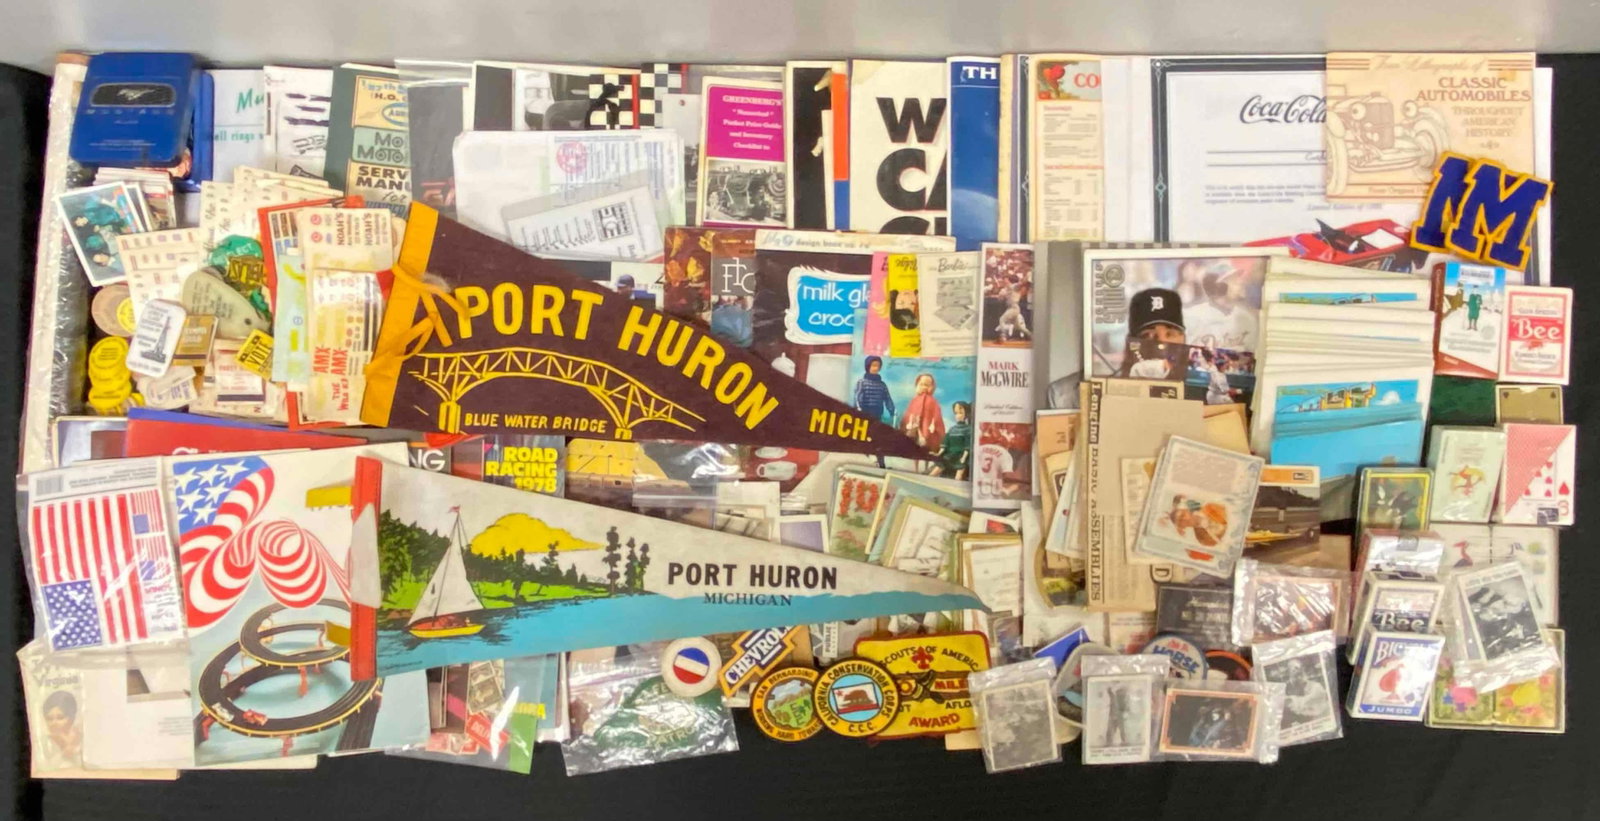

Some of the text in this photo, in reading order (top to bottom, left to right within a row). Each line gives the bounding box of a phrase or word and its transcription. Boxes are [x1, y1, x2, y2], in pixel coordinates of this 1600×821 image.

[961, 66, 997, 80] TH
[1438, 77, 1508, 89] CLASSIC
[1416, 90, 1533, 103] AUTOMOBILES
[1239, 94, 1327, 124] Coca-Cola
[1452, 106, 1526, 116] THROUGHOUT
[1463, 117, 1517, 127] AMERICAN
[1445, 157, 1554, 271] M
[802, 282, 844, 302] milk
[1517, 318, 1562, 340] Bee
[313, 346, 330, 374] AMX
[330, 349, 348, 376] AMX
[453, 284, 780, 431] PORT HURON
[988, 361, 1019, 371] MARK
[464, 412, 608, 434] BLUE WATER BRIDGE
[808, 408, 873, 443] MICH.
[503, 446, 558, 463] ROAD
[485, 461, 558, 477] RACING
[981, 457, 994, 473] 3
[513, 476, 558, 493] 1978
[667, 562, 838, 590] PORT HURON
[703, 592, 793, 607] MICHIGAN
[925, 645, 937, 654] OF
[816, 663, 895, 726] CALIFORNIA CONSERVATION CORPS
[1366, 705, 1413, 715] JUMBO
[908, 713, 961, 729] AWARD
